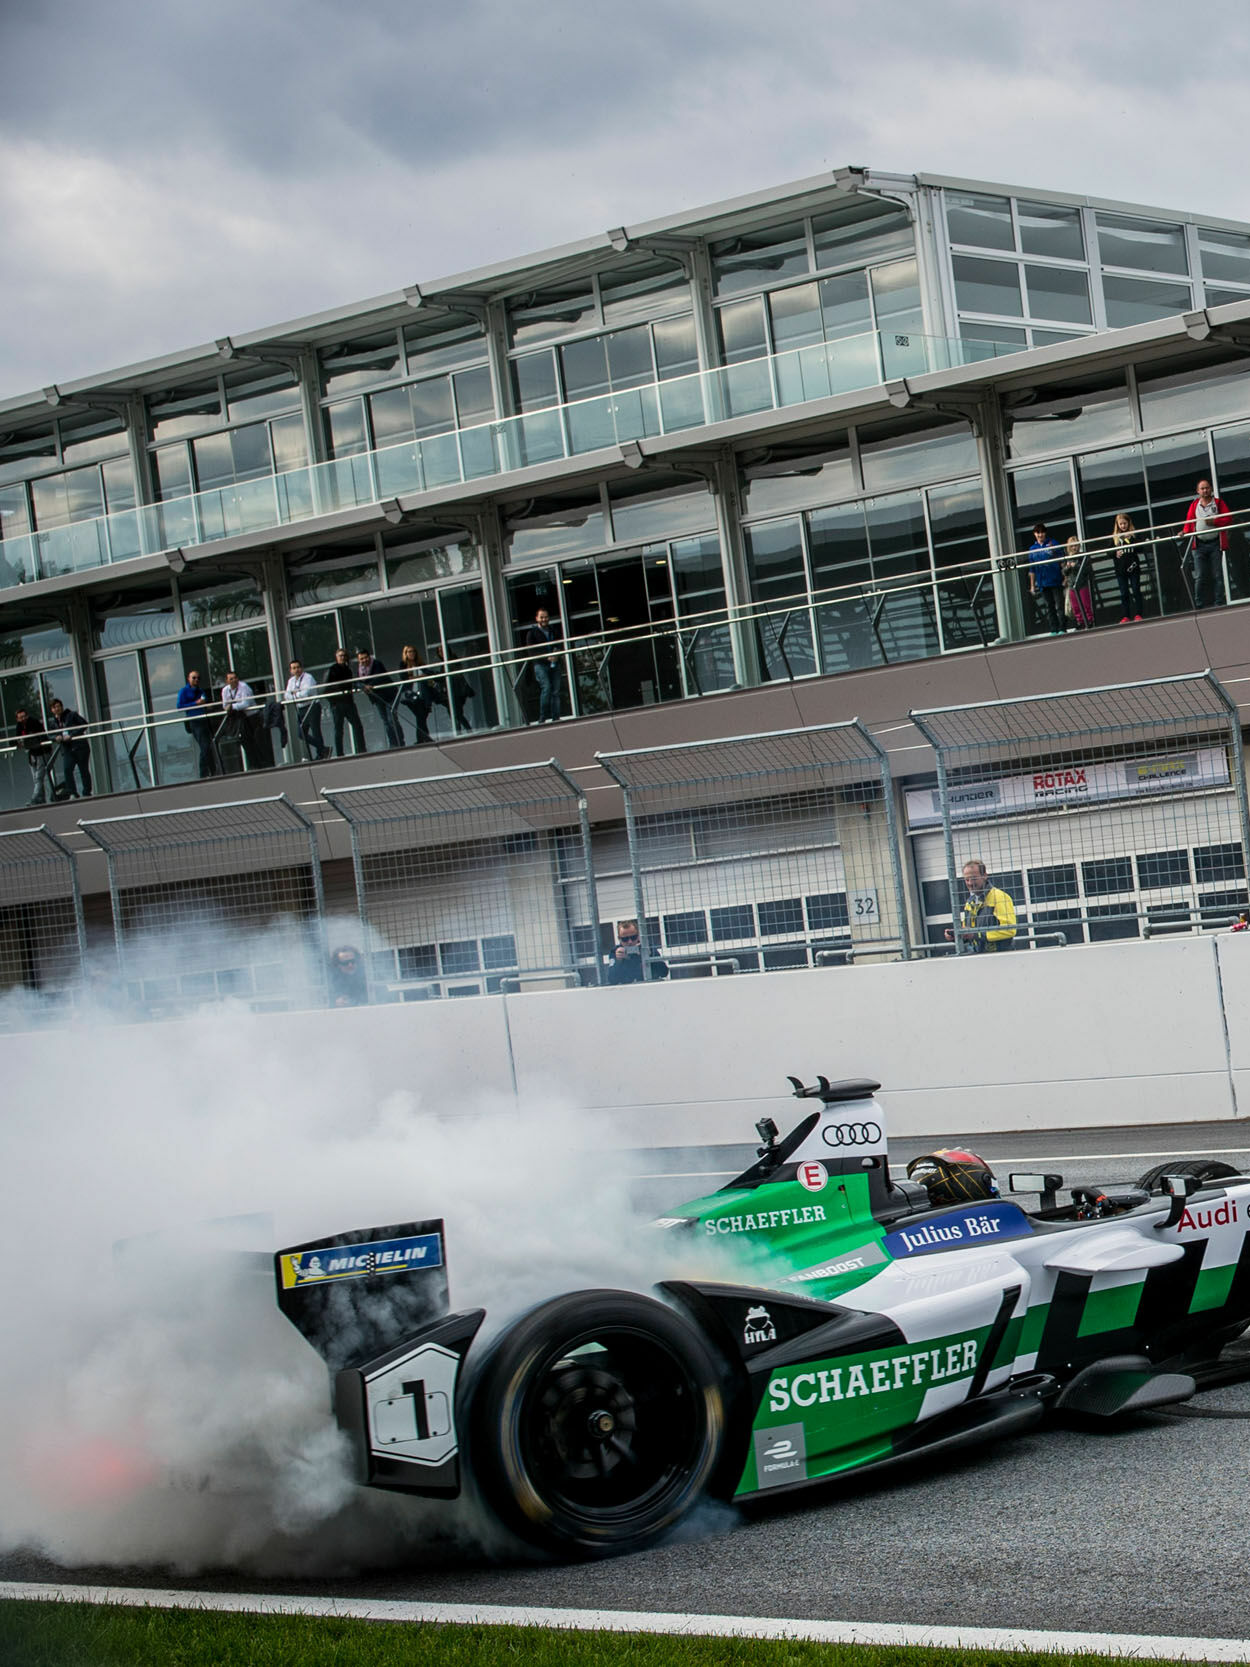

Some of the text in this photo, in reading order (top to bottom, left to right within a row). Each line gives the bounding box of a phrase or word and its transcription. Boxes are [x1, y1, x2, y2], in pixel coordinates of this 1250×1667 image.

[1033, 769, 1087, 790] ROTAX
[854, 897, 875, 915] 32
[803, 1165, 822, 1187] E
[704, 1205, 827, 1236] SCHAEFFLER
[1177, 1199, 1238, 1233] Audi
[900, 1216, 1000, 1253] Julius Bär
[768, 1339, 978, 1413] SCHAEFFLER
[402, 1379, 430, 1441] 1
